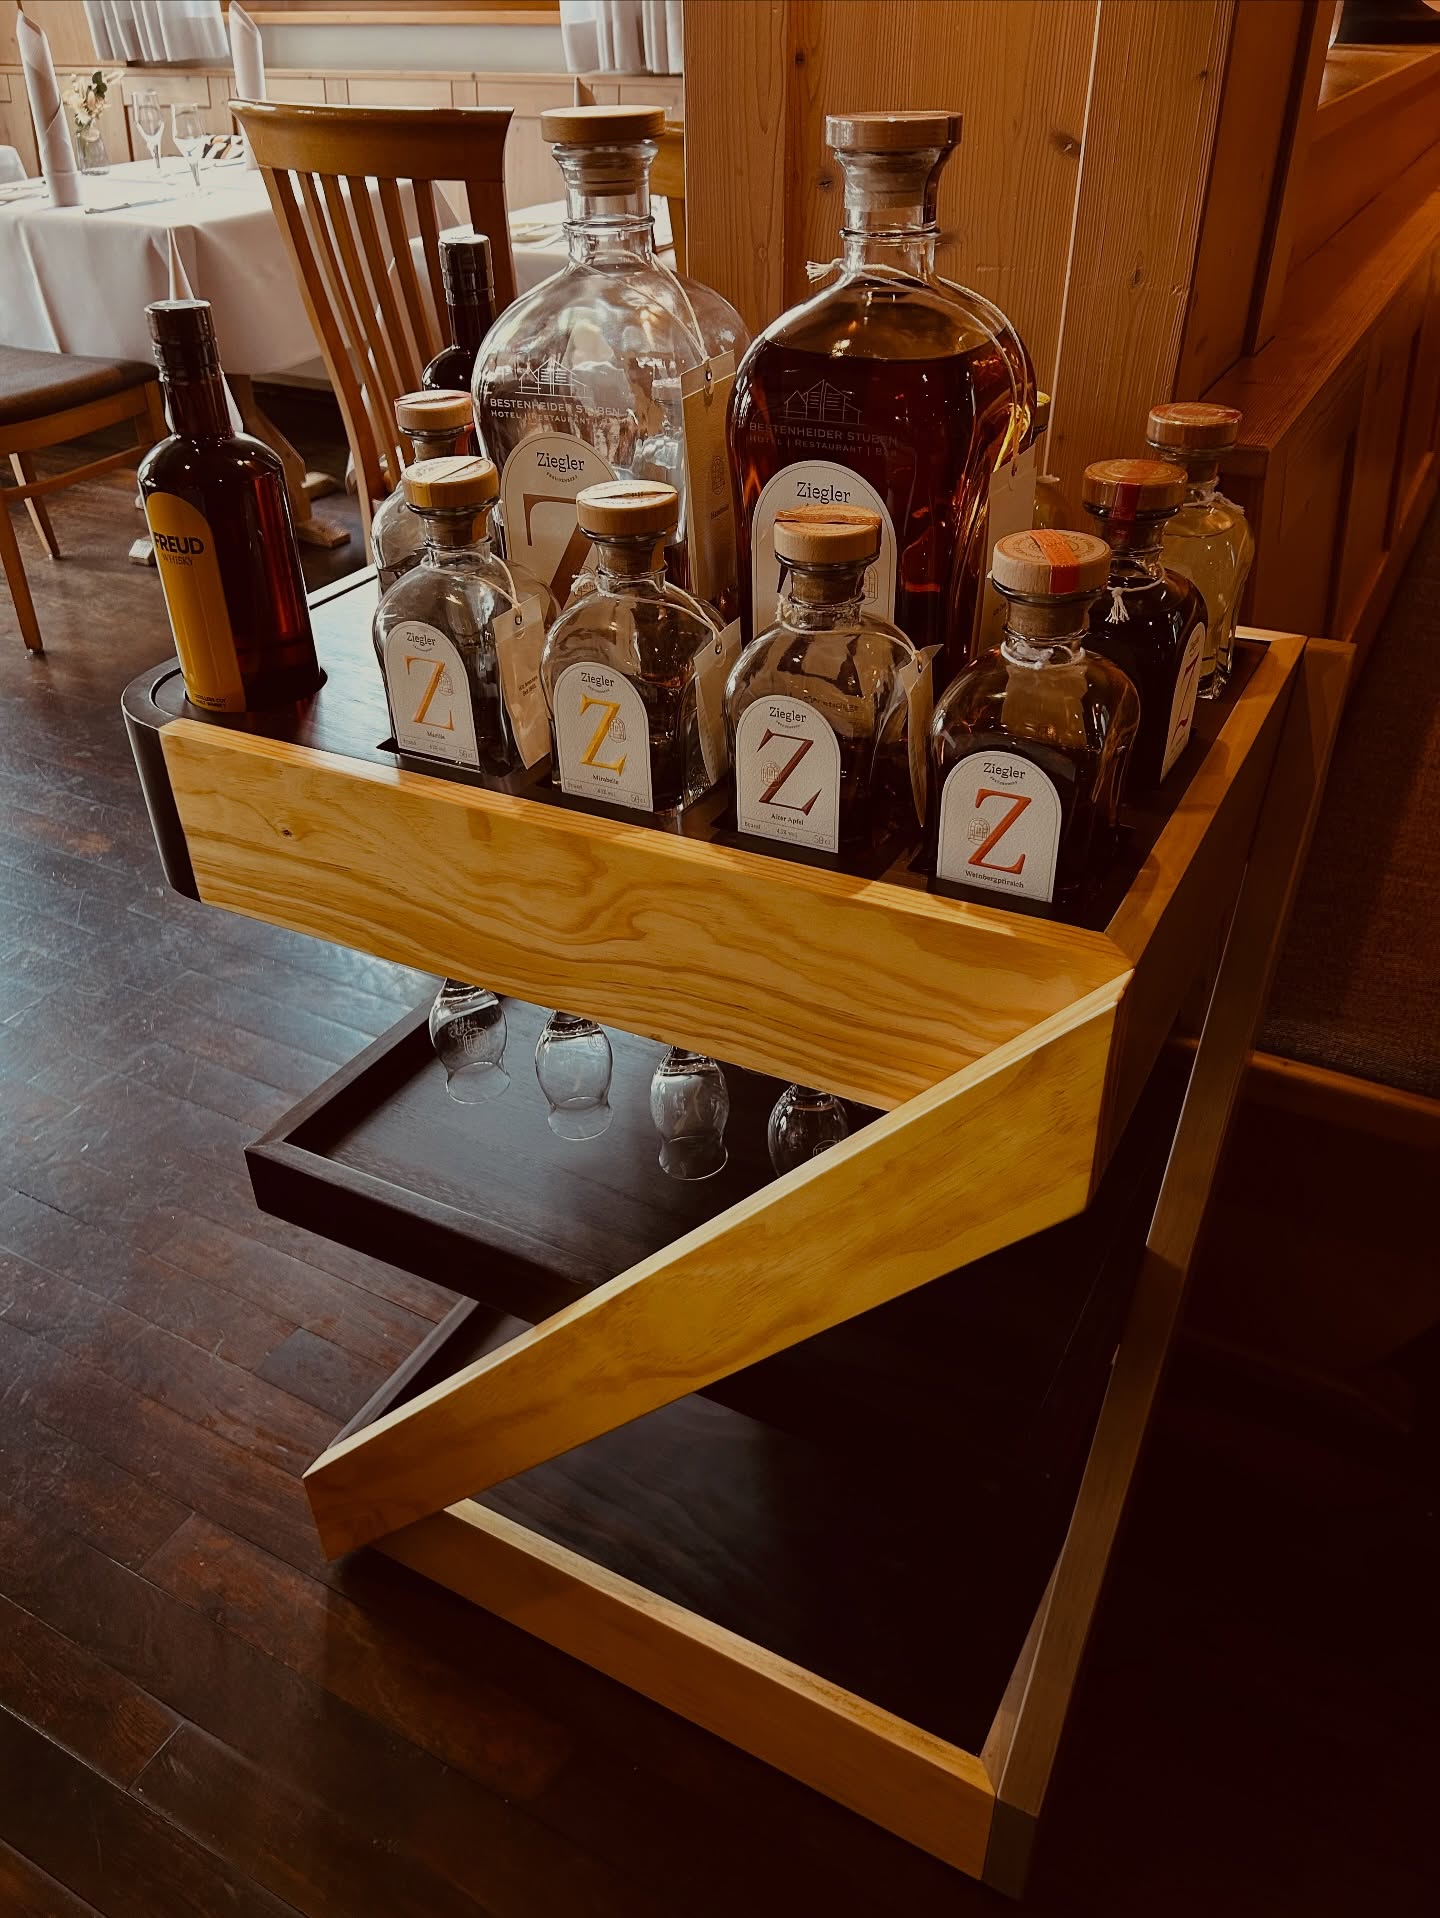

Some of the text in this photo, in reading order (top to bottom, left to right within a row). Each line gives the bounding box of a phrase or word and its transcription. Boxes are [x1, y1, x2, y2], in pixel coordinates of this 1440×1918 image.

[490, 398, 572, 412] BESTENHEIDER
[490, 410, 521, 418] HOTEL
[749, 422, 898, 445] BESTENHEIDER STUBEN
[749, 434, 783, 446] HOTL
[794, 439, 863, 456] RESTAURANT
[536, 452, 585, 472] Ziegler
[796, 481, 851, 504] Ziegler
[153, 532, 205, 554] FREUD
[161, 553, 193, 567] WHISKY
[406, 632, 436, 646] Ziegler
[580, 672, 615, 687] Ziegler
[404, 656, 454, 731] Z
[769, 706, 807, 723] Ziegler
[580, 693, 627, 776] Z
[757, 728, 822, 816] Z
[983, 762, 1026, 779] Ziegler
[771, 813, 804, 826] Alter Apfel
[967, 788, 1032, 875] Z
[965, 870, 1024, 888] Weinbergpfirsich
